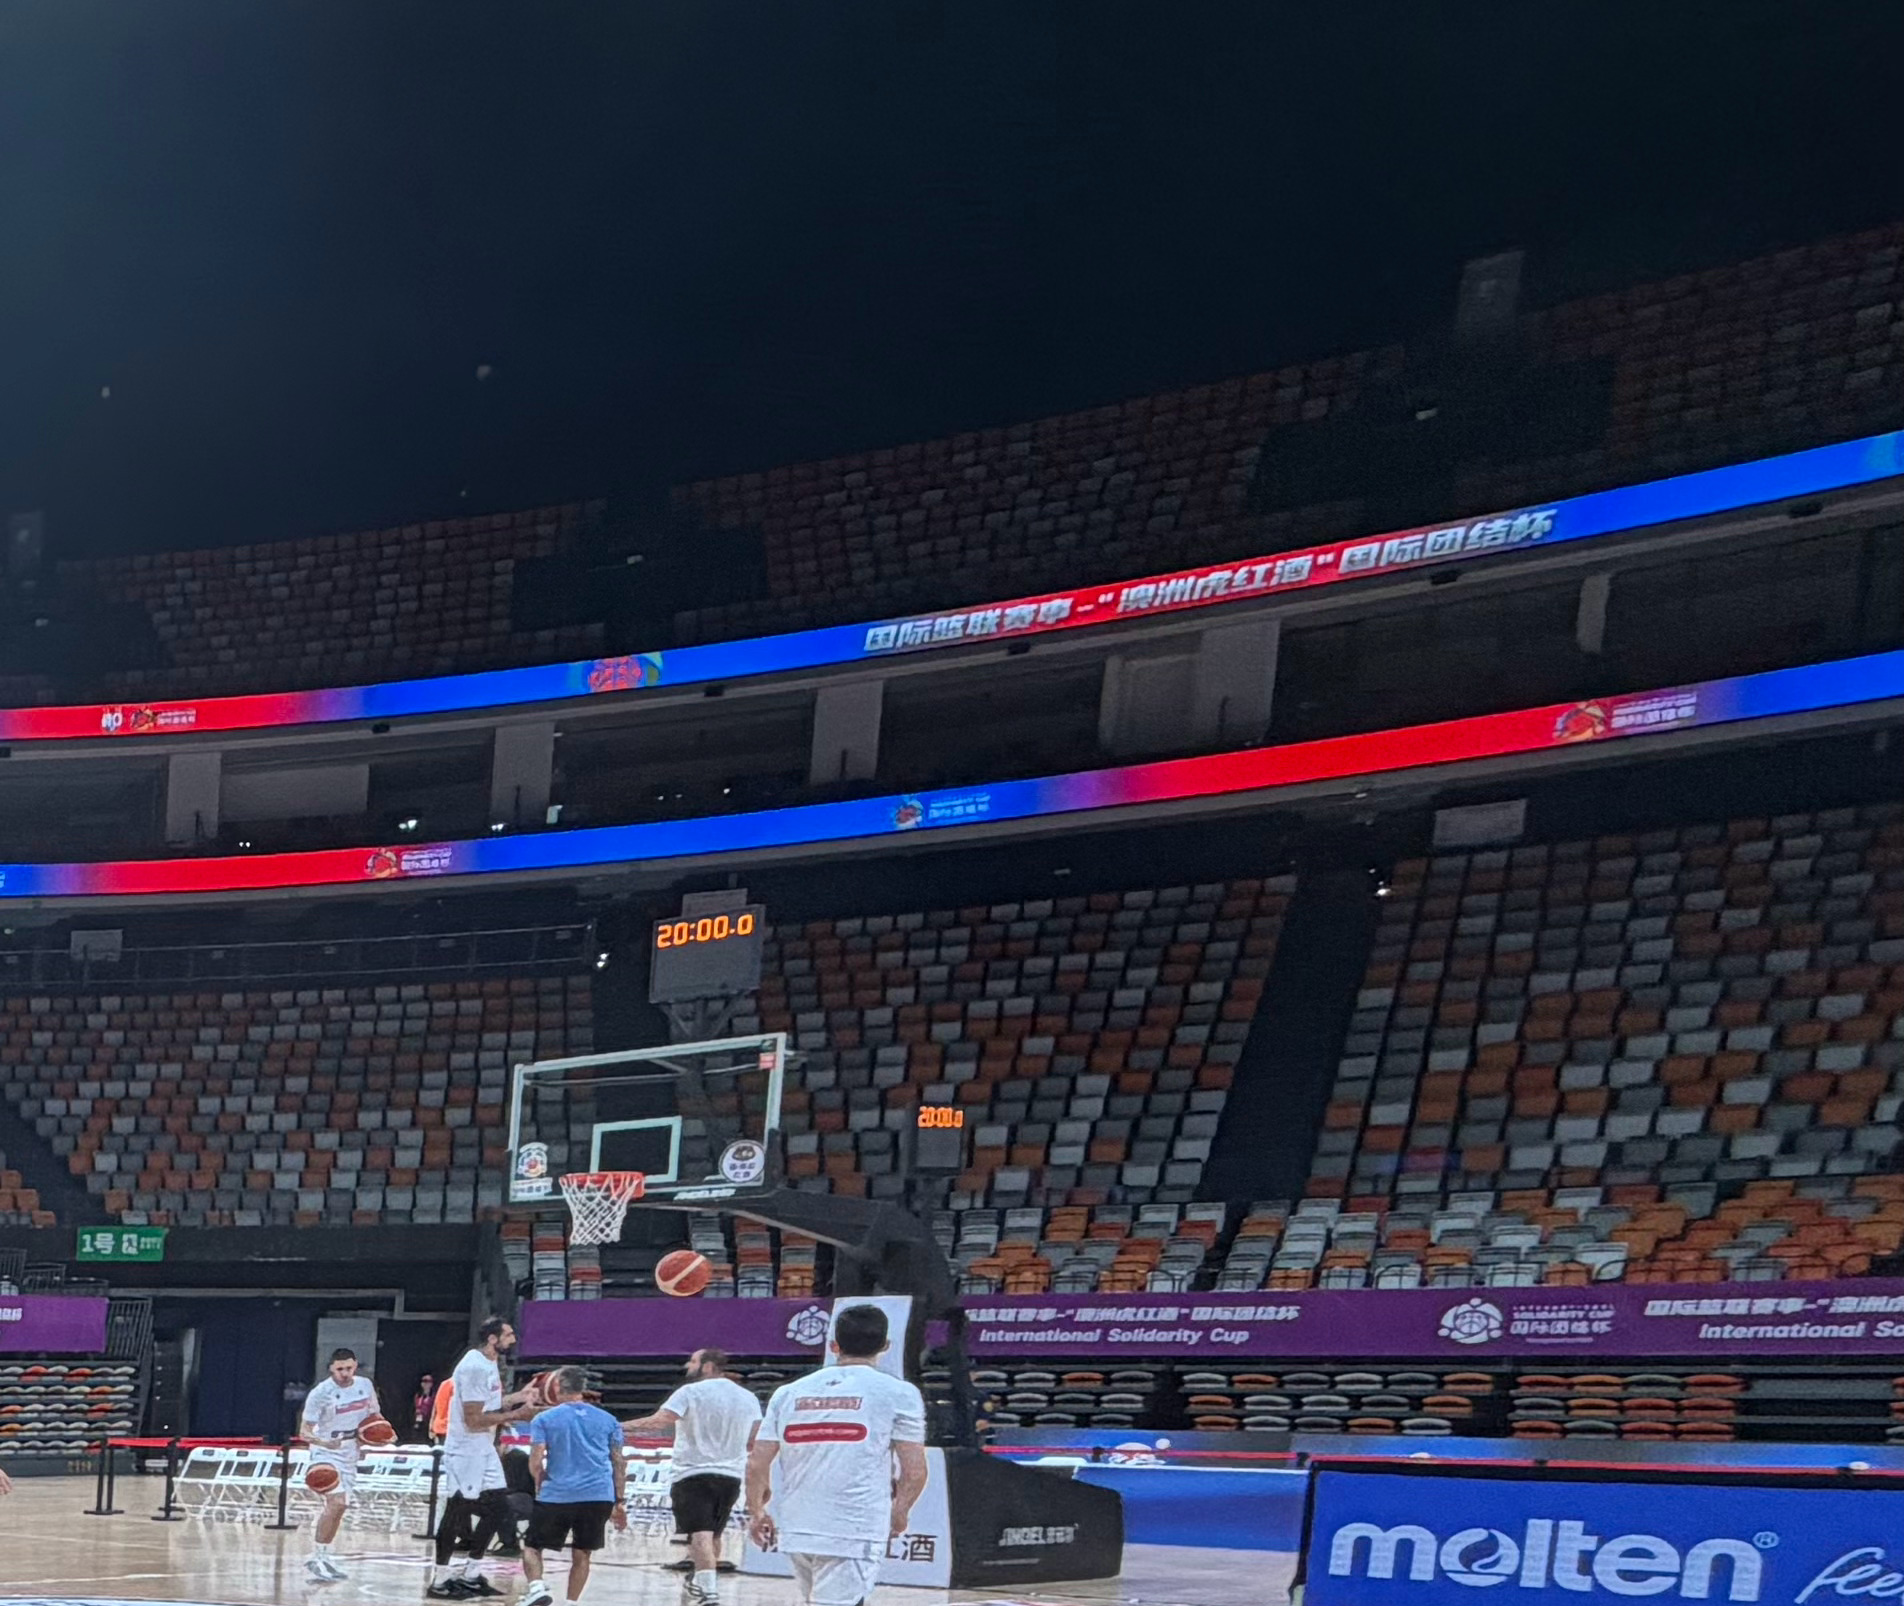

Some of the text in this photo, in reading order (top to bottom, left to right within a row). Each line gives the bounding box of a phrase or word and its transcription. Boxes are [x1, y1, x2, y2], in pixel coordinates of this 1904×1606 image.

[657, 913, 753, 949] 20:00.0
[979, 1327, 1250, 1345] International Solidarity Cup
[1698, 1322, 1865, 1339] International
[1328, 1517, 1765, 1602] molten
